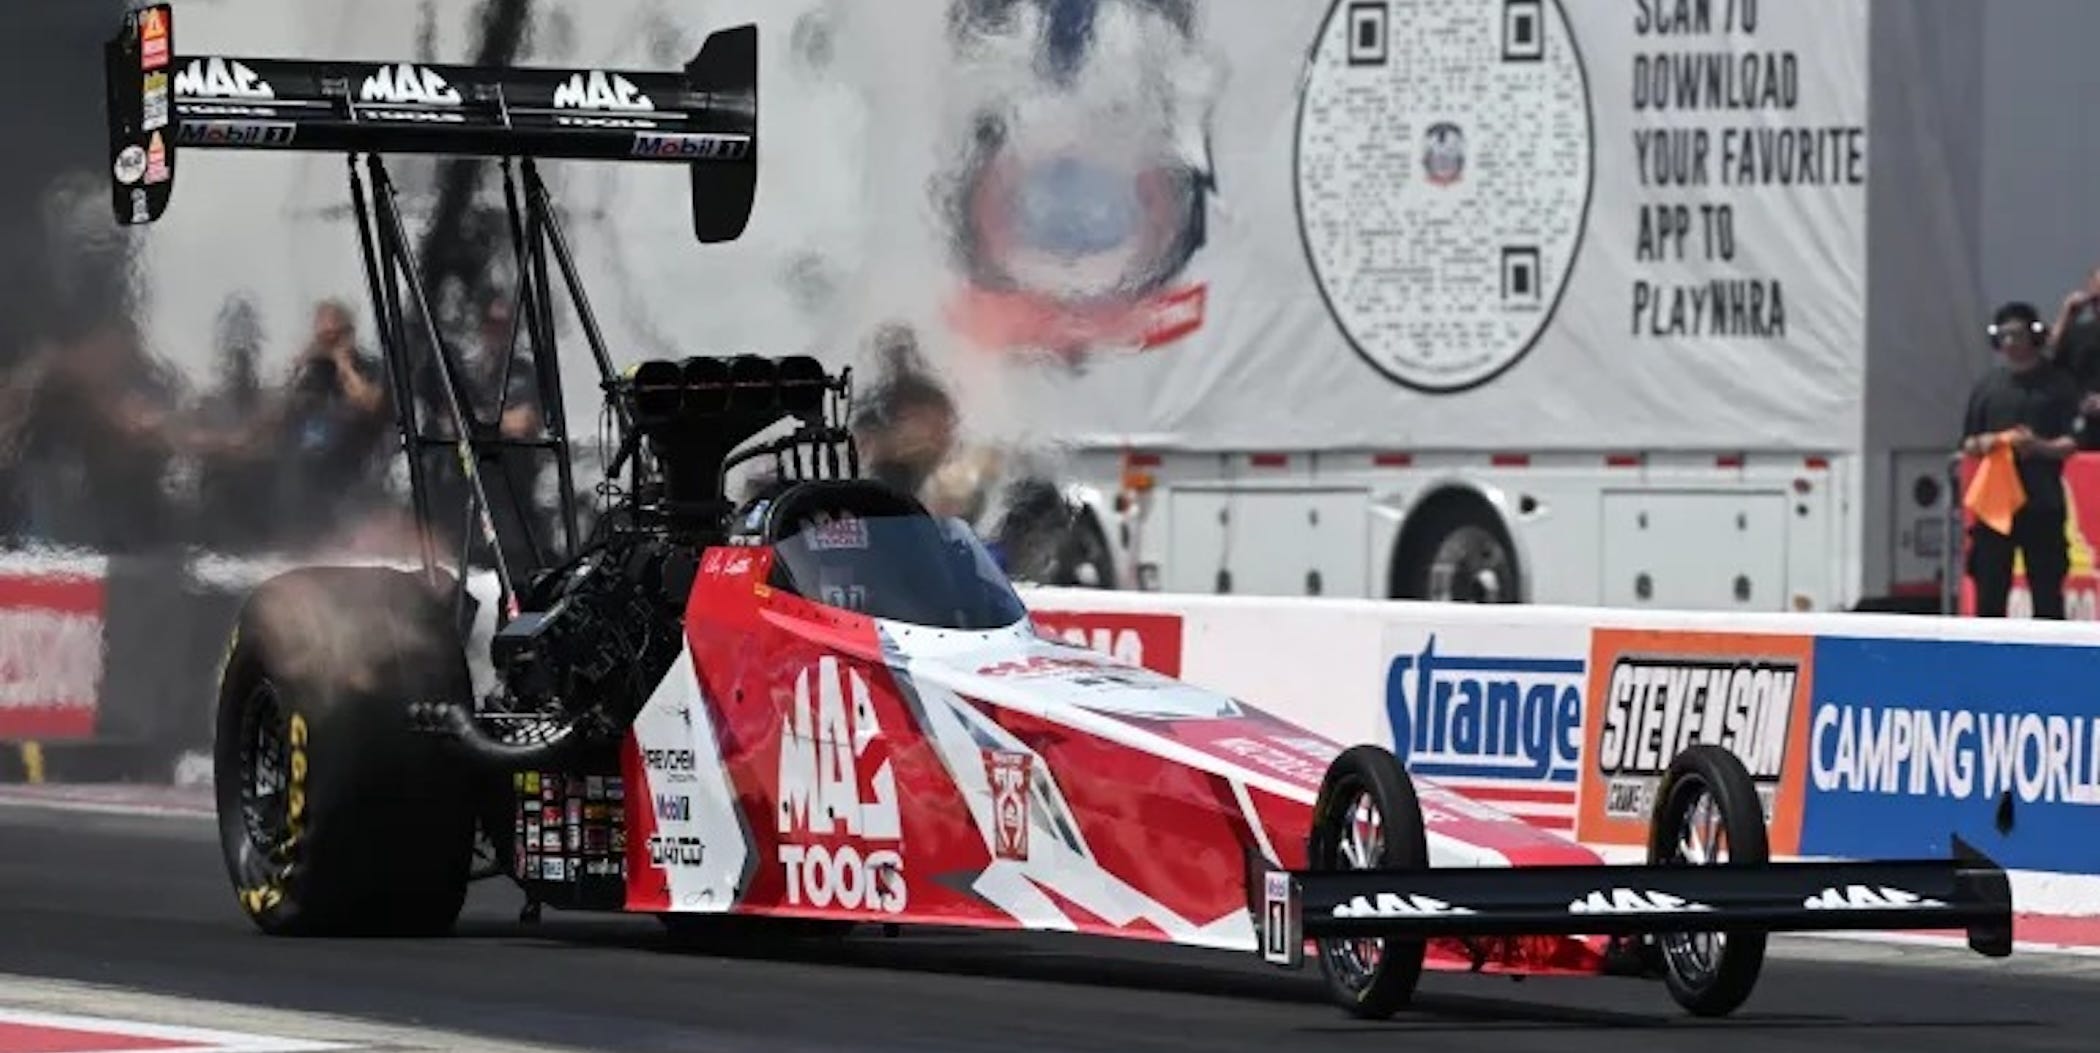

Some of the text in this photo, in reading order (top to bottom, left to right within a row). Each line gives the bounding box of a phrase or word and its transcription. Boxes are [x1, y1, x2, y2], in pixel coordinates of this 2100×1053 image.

[174, 57, 276, 99] MAC
[361, 63, 461, 104] MAC
[554, 70, 655, 111] MAC
[1634, 53, 1798, 110] DOWNLOAD
[181, 123, 259, 143] Mobil
[635, 136, 719, 157] Mobil
[1634, 128, 1864, 186] YOUR FAVORITE
[1636, 203, 1735, 262] APP TO
[1385, 632, 1585, 781] Strange
[1600, 661, 1797, 778] STEVENSON
[778, 655, 903, 841] MAC
[1810, 703, 2100, 806] CAMPING WORL
[778, 844, 907, 914] TOOLS
